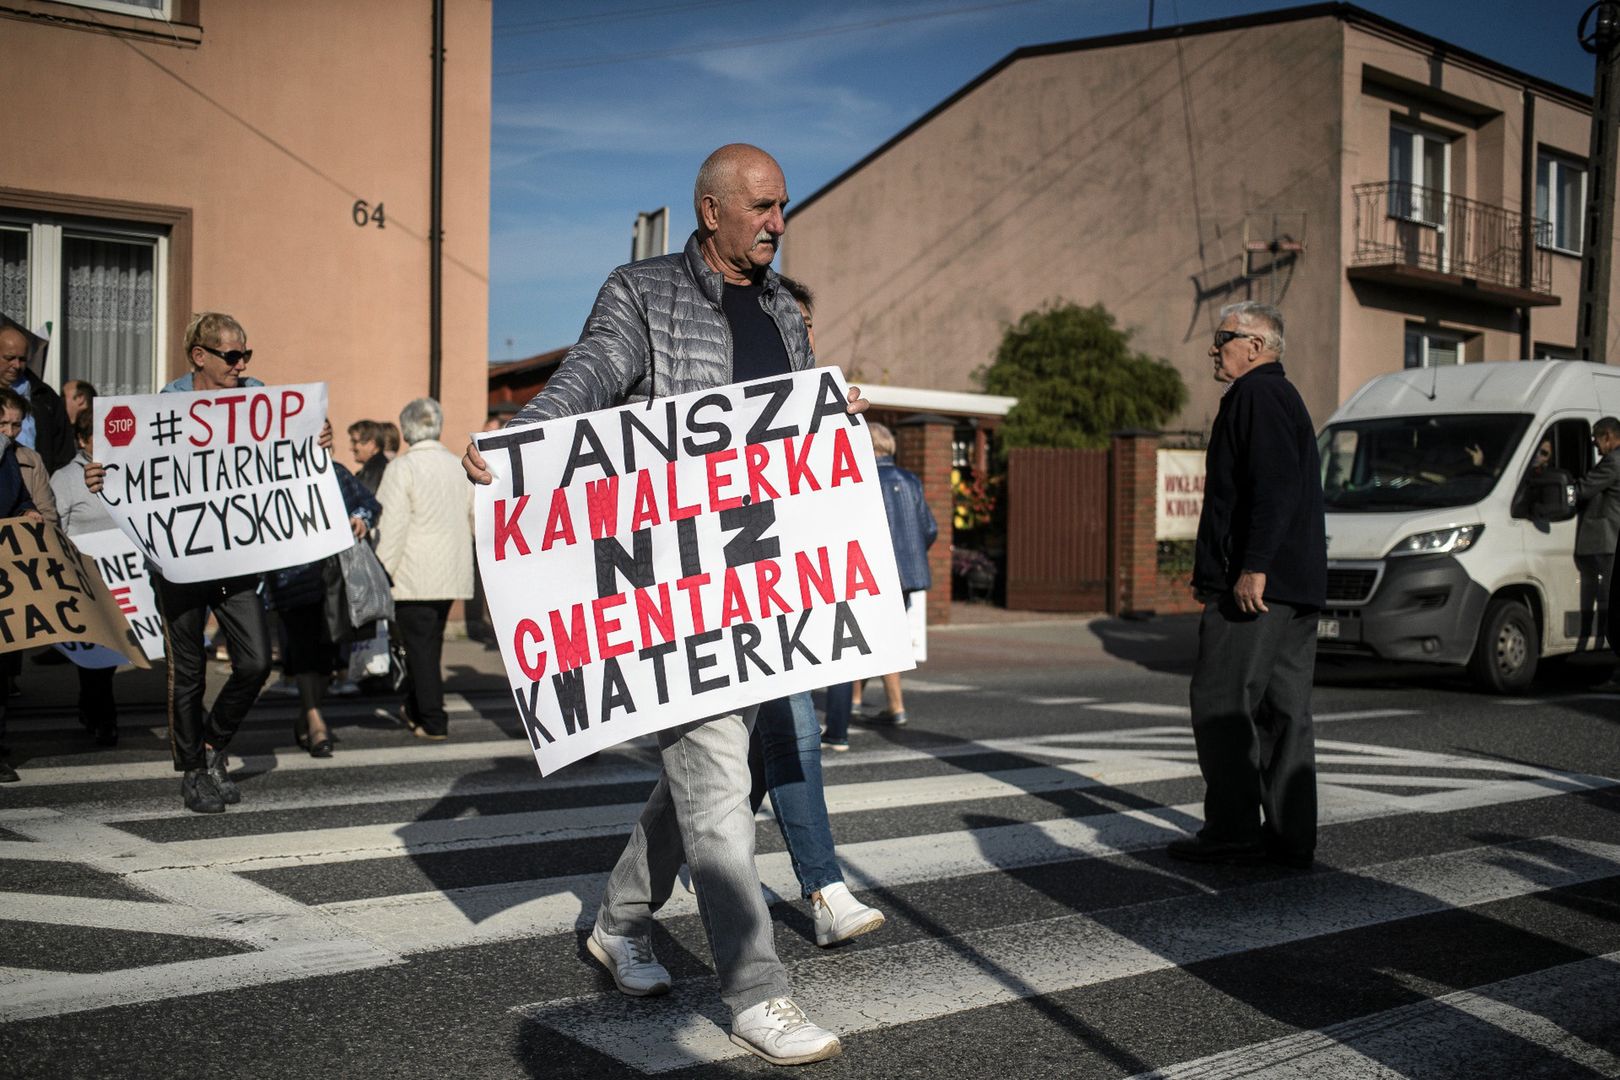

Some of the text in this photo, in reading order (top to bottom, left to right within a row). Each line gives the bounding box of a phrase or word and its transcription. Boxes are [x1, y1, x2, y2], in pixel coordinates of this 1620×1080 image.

[353, 199, 385, 229] 64
[108, 418, 133, 433] STOP
[150, 391, 304, 447] #STOP
[478, 371, 861, 498] TAŃSZA
[99, 436, 328, 506] CMENTARNEMU
[494, 428, 863, 561] KAWALERKA
[1166, 499, 1200, 516] KWIA
[128, 483, 331, 559] WYZYSKOWI
[594, 495, 781, 598] NIŻ
[513, 539, 880, 681] CMENTARNA
[516, 600, 872, 749] KWATERKA
